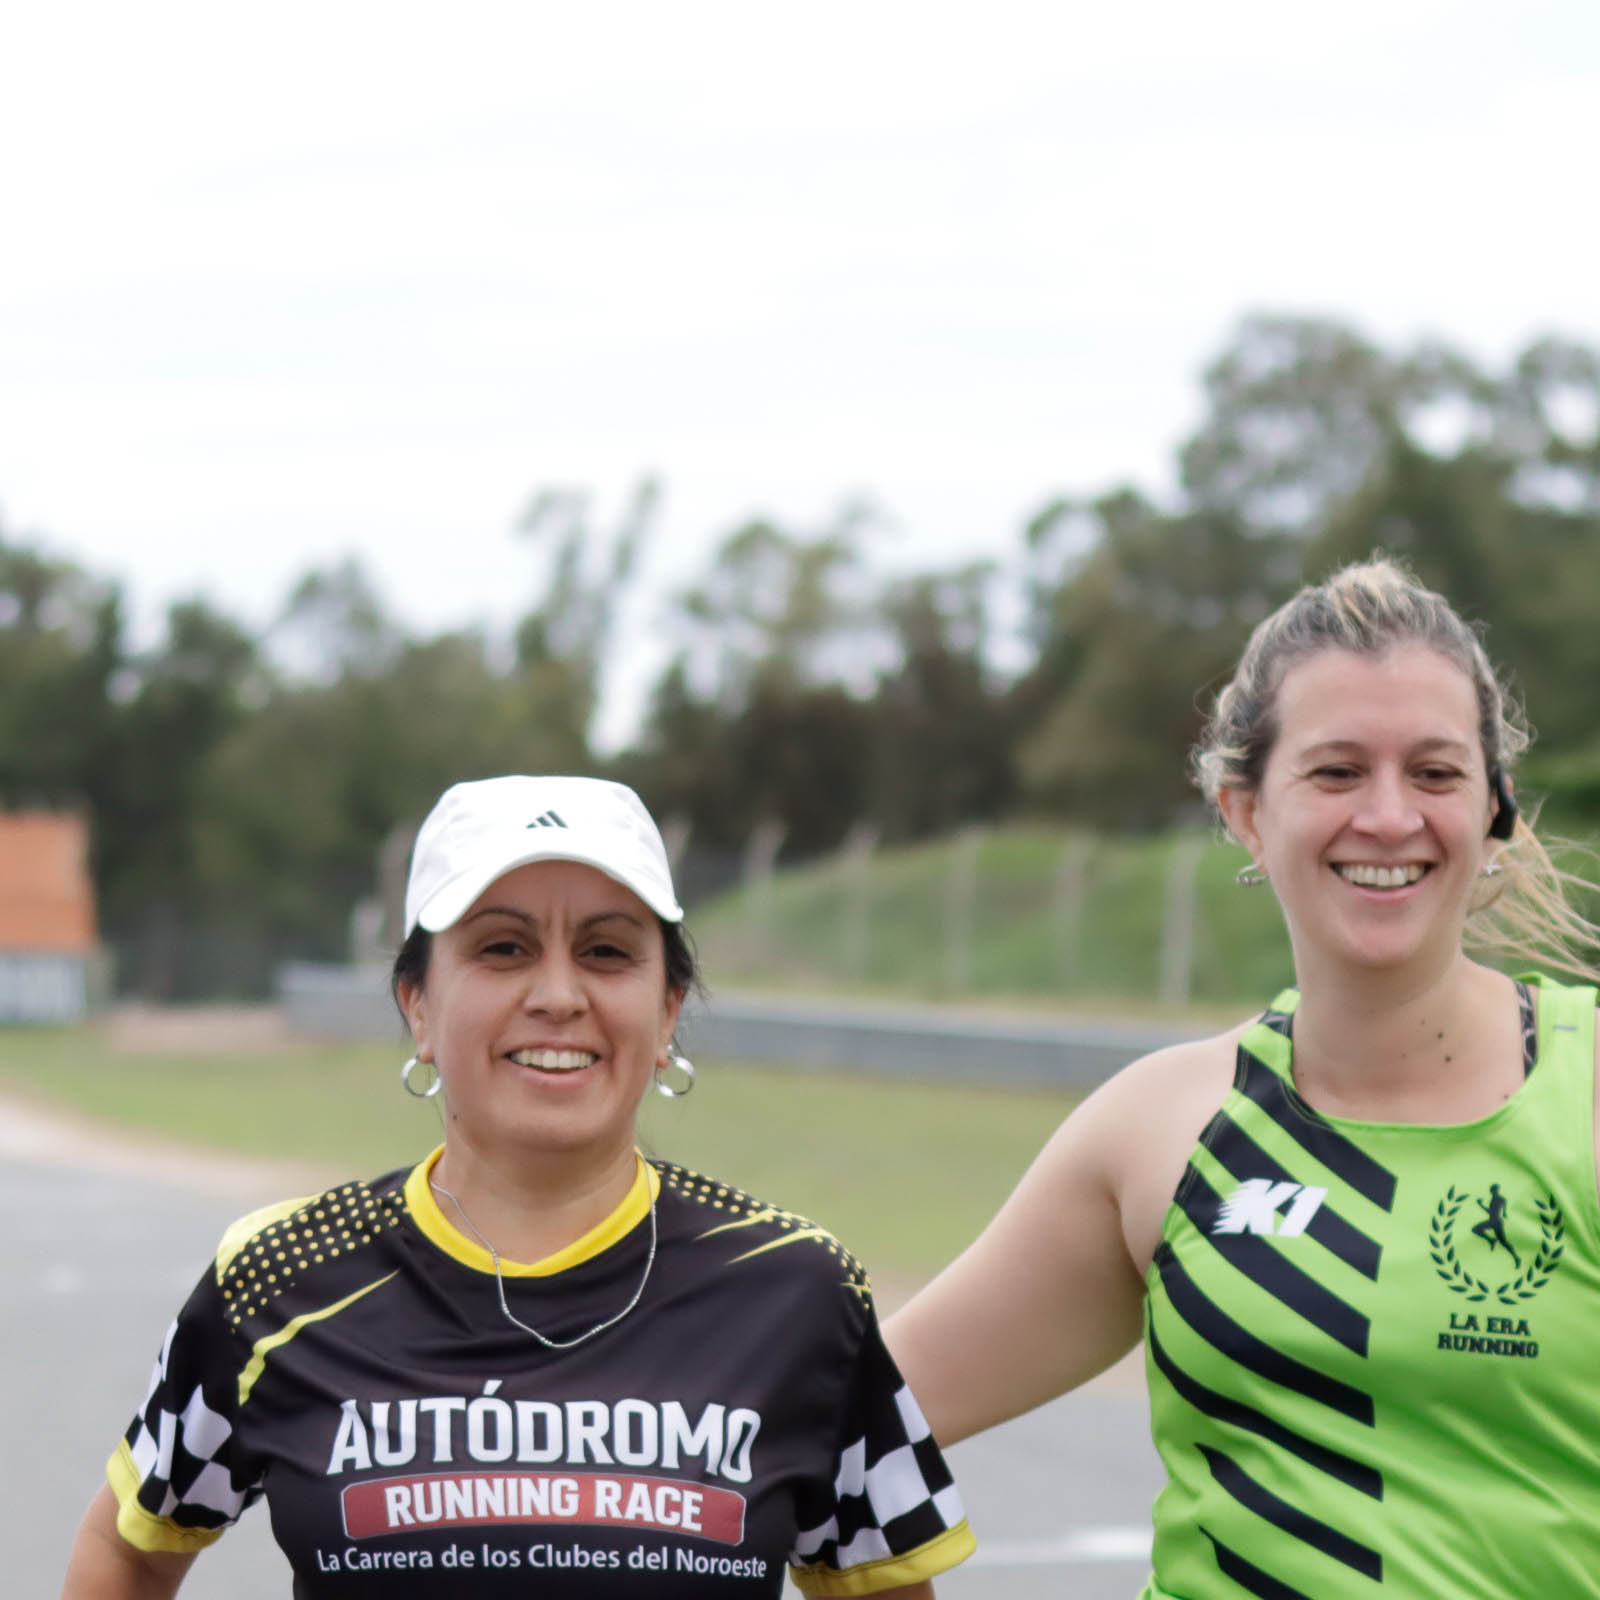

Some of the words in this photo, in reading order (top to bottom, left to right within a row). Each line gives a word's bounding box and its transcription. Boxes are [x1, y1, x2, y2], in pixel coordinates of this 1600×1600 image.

[1450, 1312, 1480, 1334] LA
[1486, 1314, 1531, 1337] ERA
[1437, 1331, 1539, 1359] RUNNING
[325, 1379, 761, 1484] AUTÓDROMO
[383, 1477, 580, 1528] RUNNING
[593, 1479, 704, 1532] RACE
[317, 1549, 340, 1573] La
[344, 1546, 434, 1571] Carrera
[440, 1543, 476, 1568] de
[482, 1544, 522, 1568] los
[527, 1544, 622, 1569] Clubes
[628, 1545, 670, 1572] del
[676, 1548, 768, 1579] Noroeste
